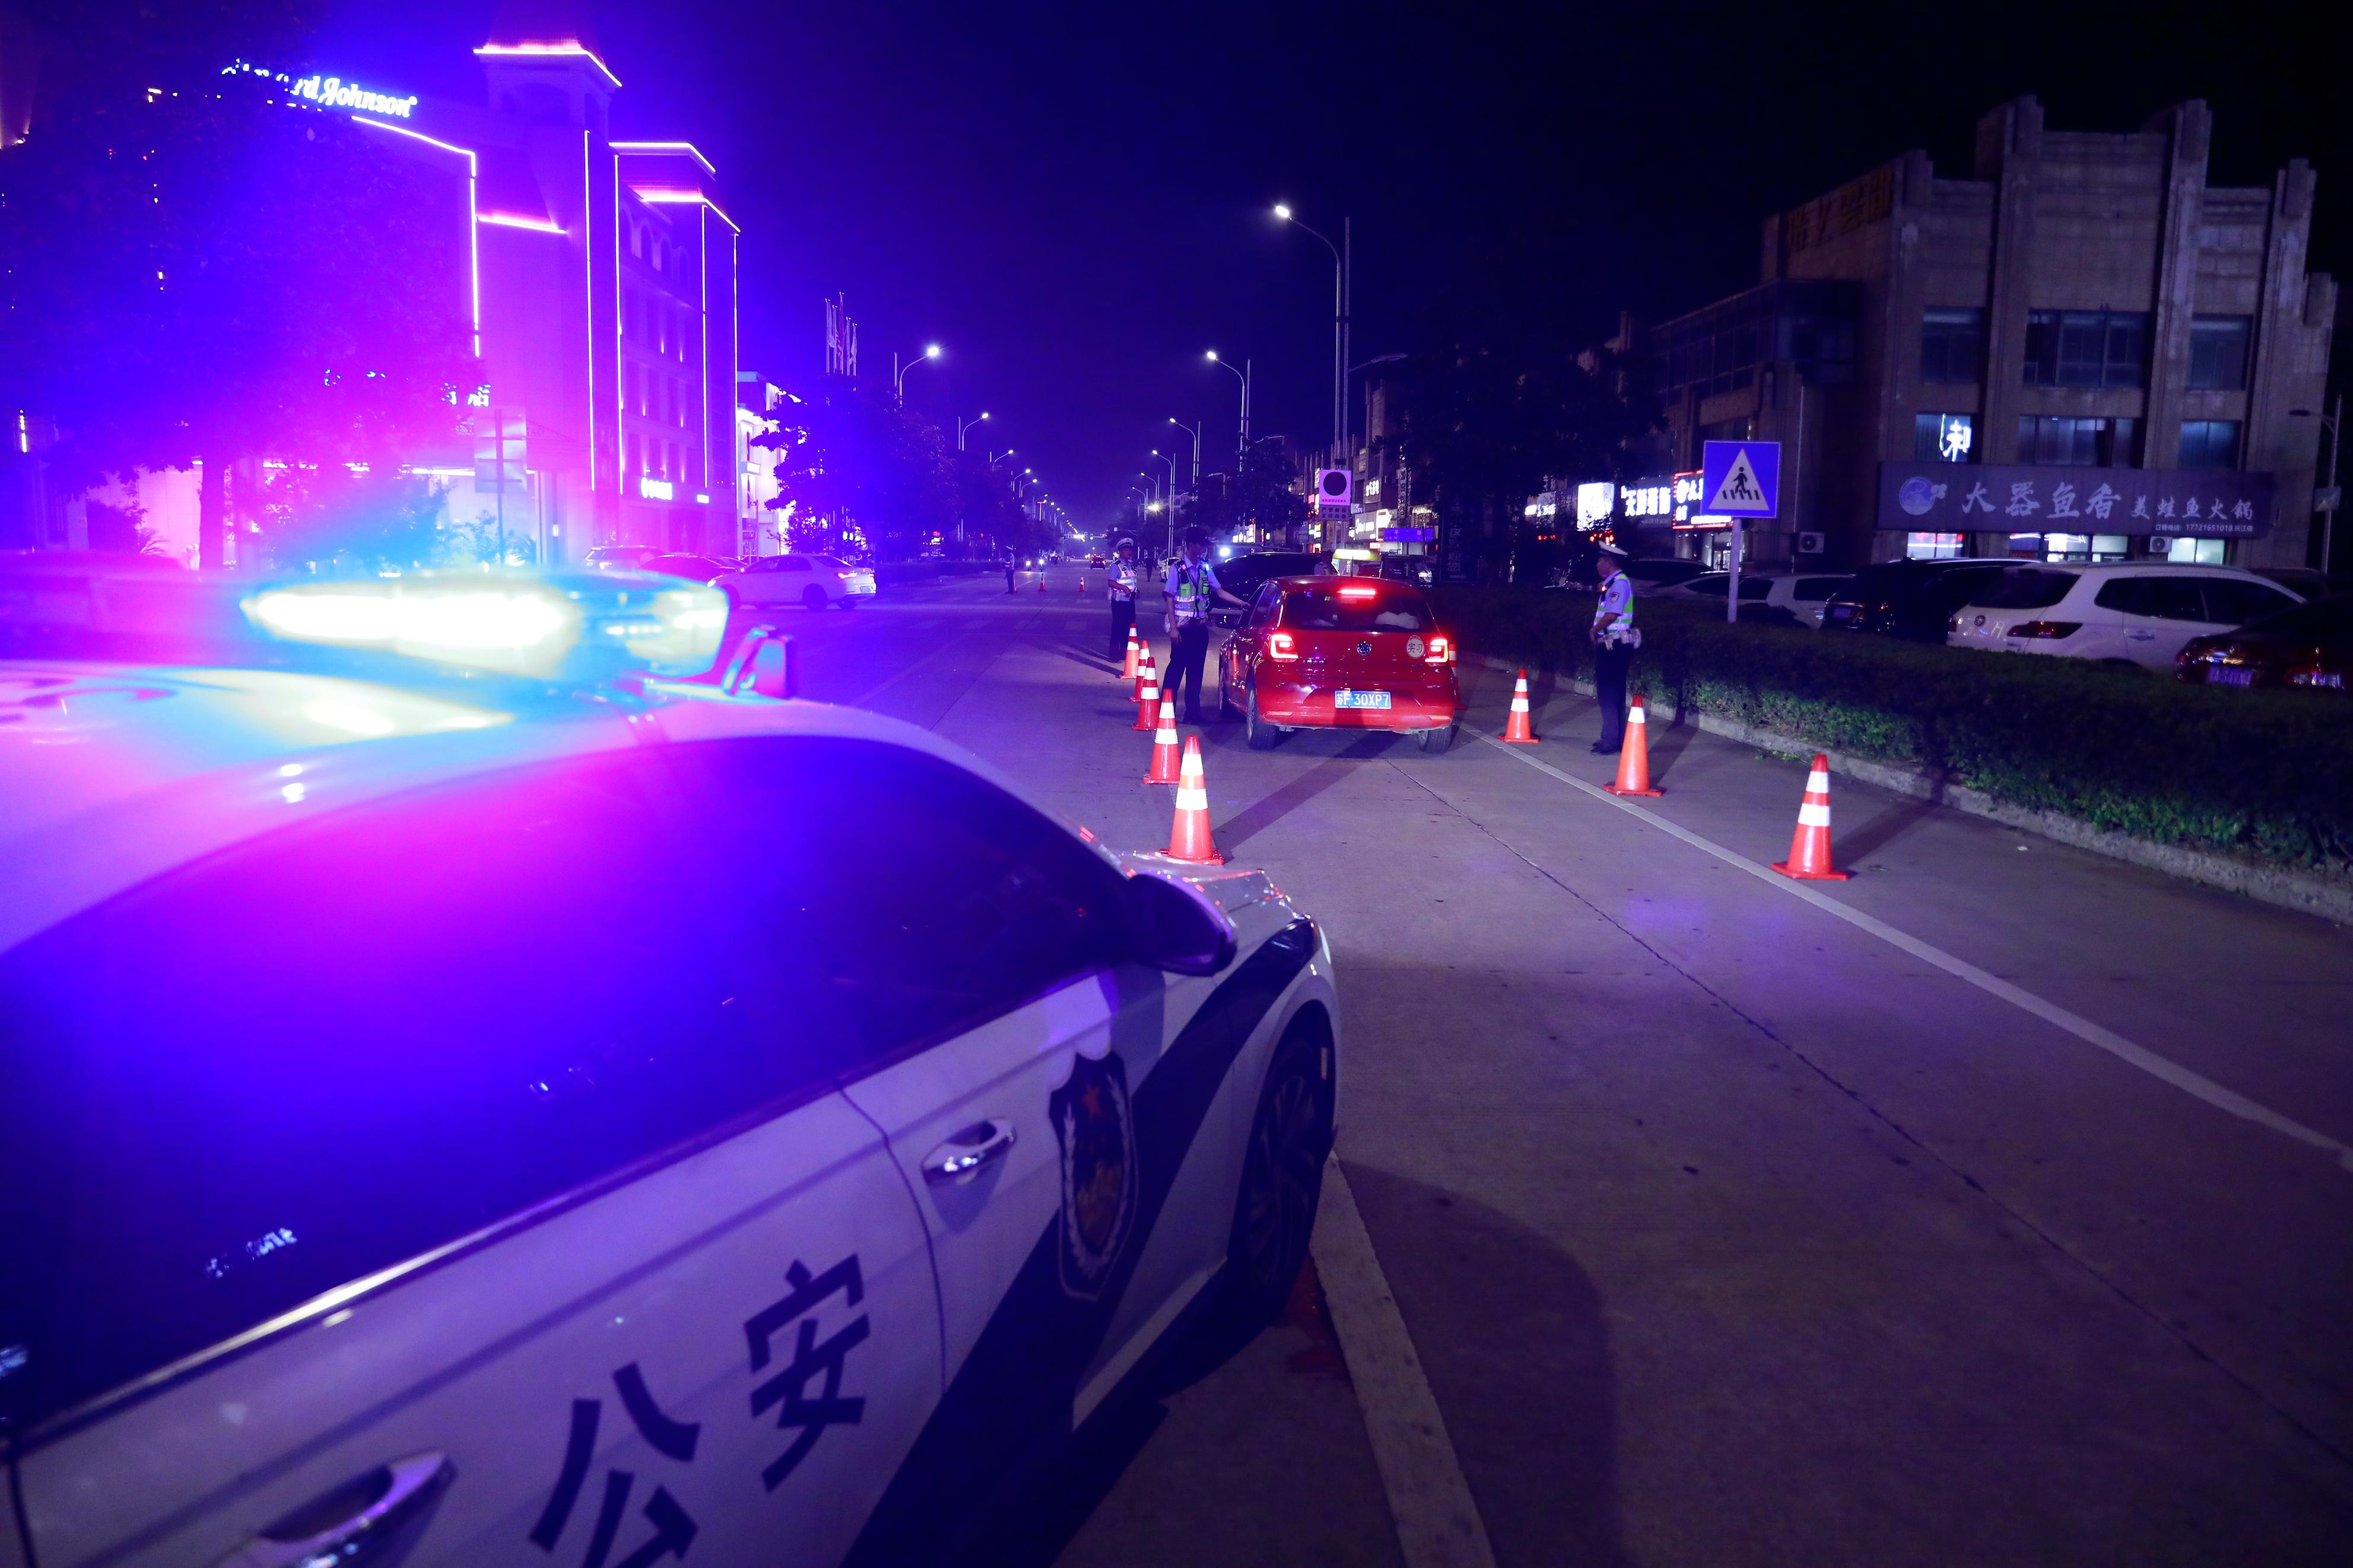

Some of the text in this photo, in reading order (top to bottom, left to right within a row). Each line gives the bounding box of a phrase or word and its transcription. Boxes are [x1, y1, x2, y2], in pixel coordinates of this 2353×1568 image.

[317, 77, 412, 117] Johnson
[1961, 481, 2122, 520] 大器鱼香
[1408, 642, 1423, 654] 实习
[529, 1252, 871, 1568] 公安
